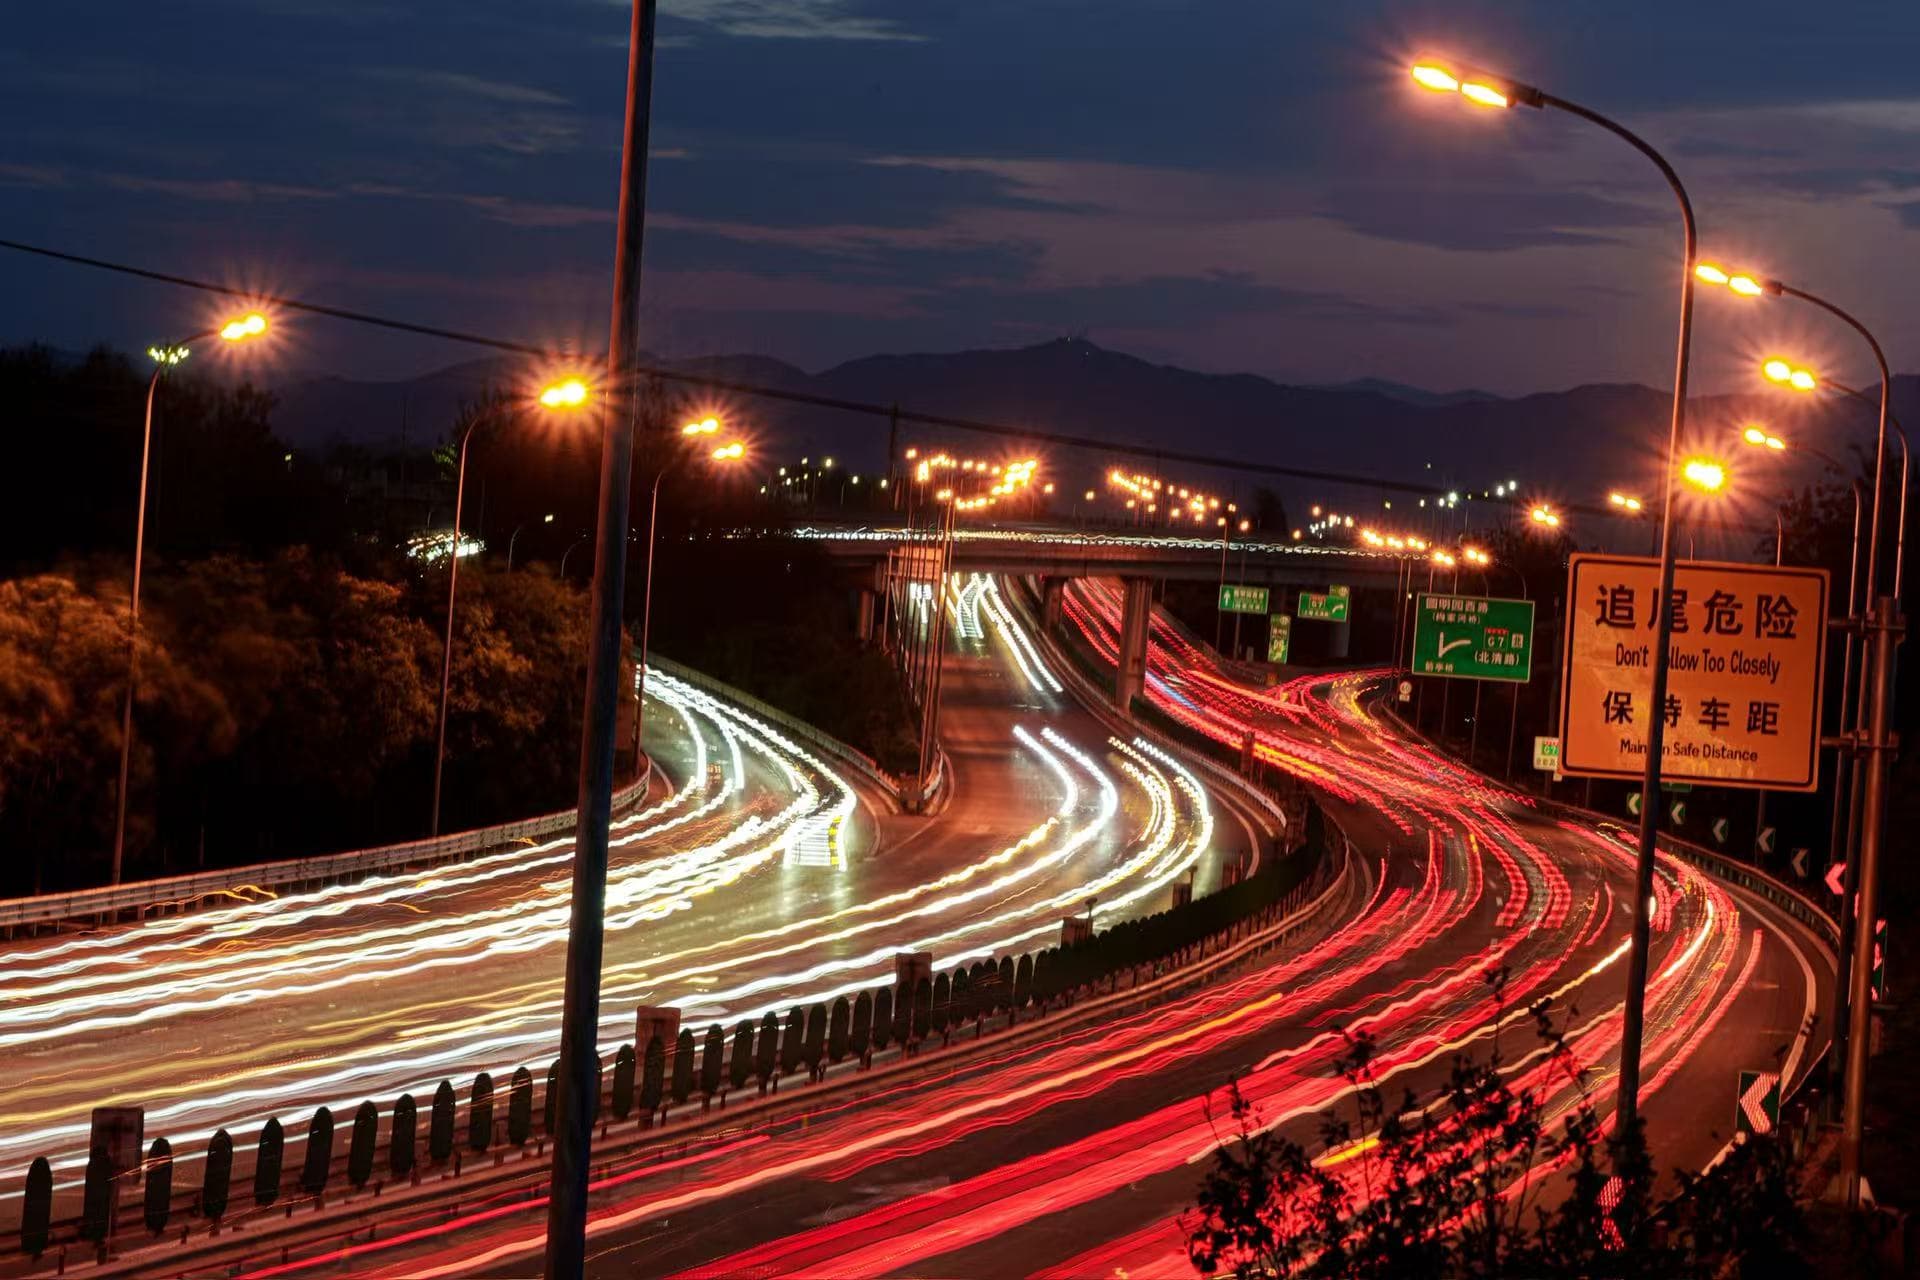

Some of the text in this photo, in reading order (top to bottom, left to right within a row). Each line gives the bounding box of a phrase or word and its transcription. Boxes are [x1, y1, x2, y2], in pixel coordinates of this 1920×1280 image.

[1596, 584, 1798, 640] 追尾危险
[1616, 643, 1781, 684] Don't llow Too Closely
[1620, 739, 1759, 762] Mainn Safe Distance
